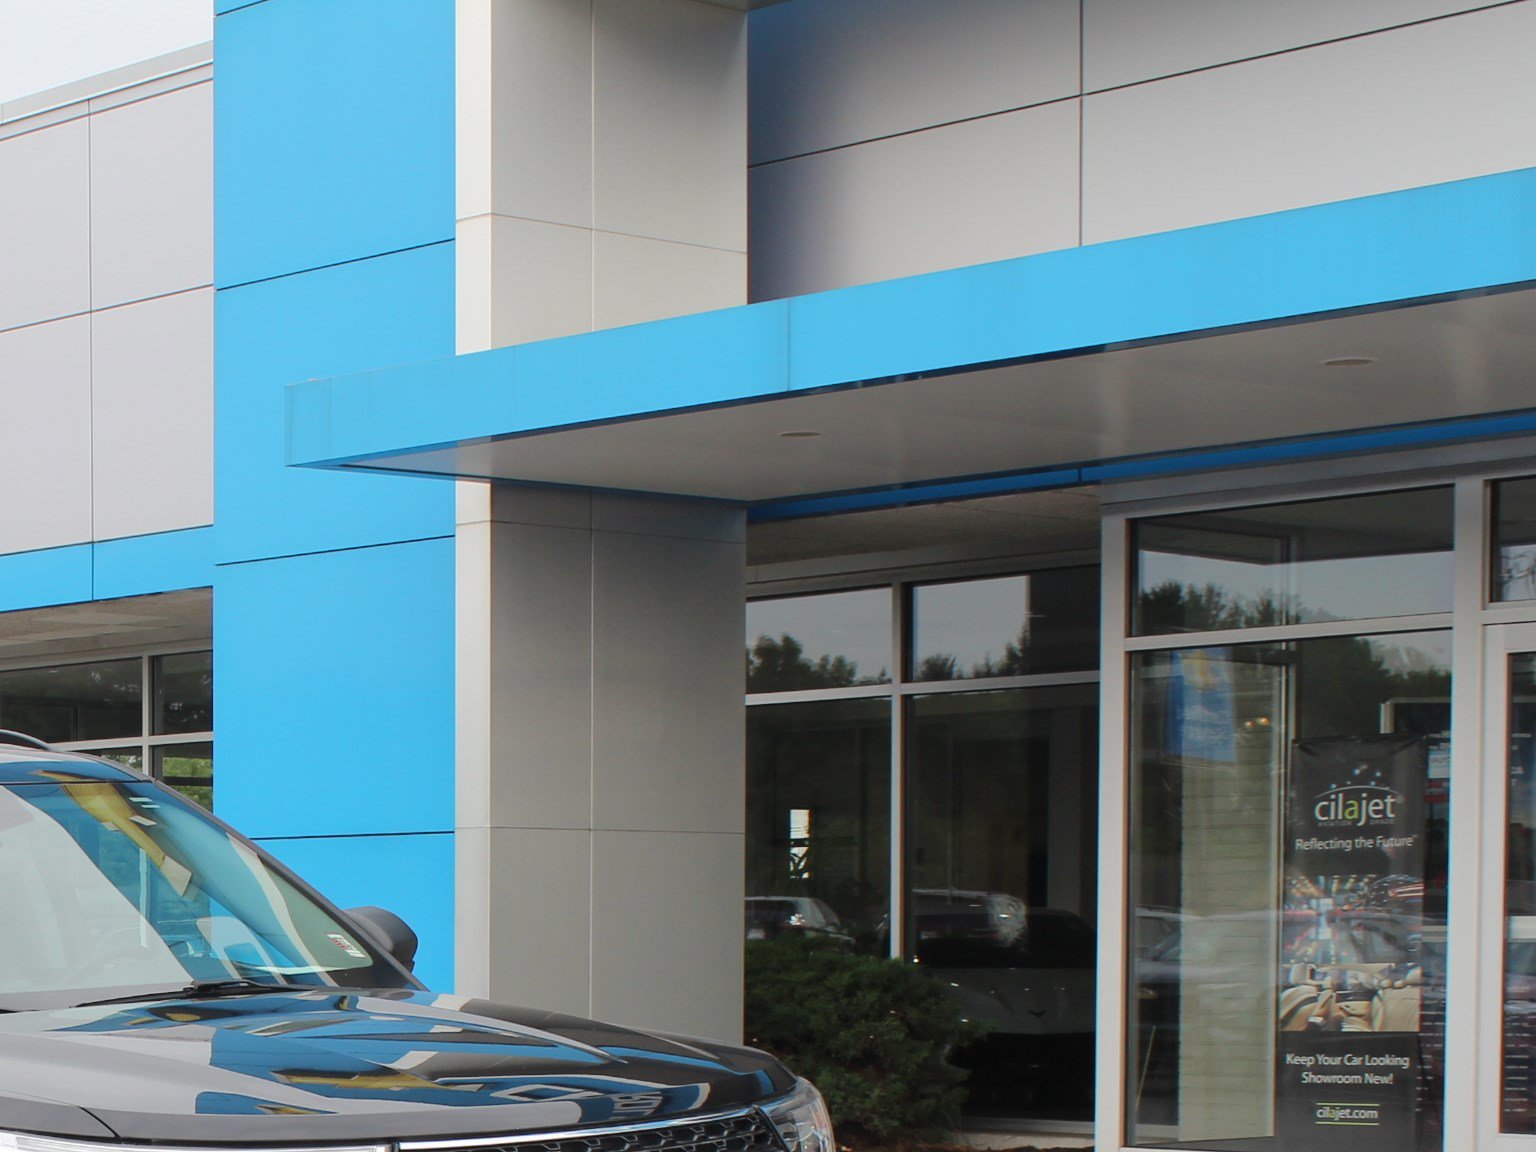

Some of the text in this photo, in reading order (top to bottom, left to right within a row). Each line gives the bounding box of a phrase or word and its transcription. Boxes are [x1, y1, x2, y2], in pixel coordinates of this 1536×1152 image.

[1314, 792, 1395, 826] cilajet
[1295, 837, 1352, 851] Reflecting
[1354, 835, 1374, 848] the
[1285, 1053, 1410, 1069] Keep Your Car Looking
[1301, 1072, 1394, 1085] Showroom New!
[1316, 1106, 1379, 1121] cilajet.com
